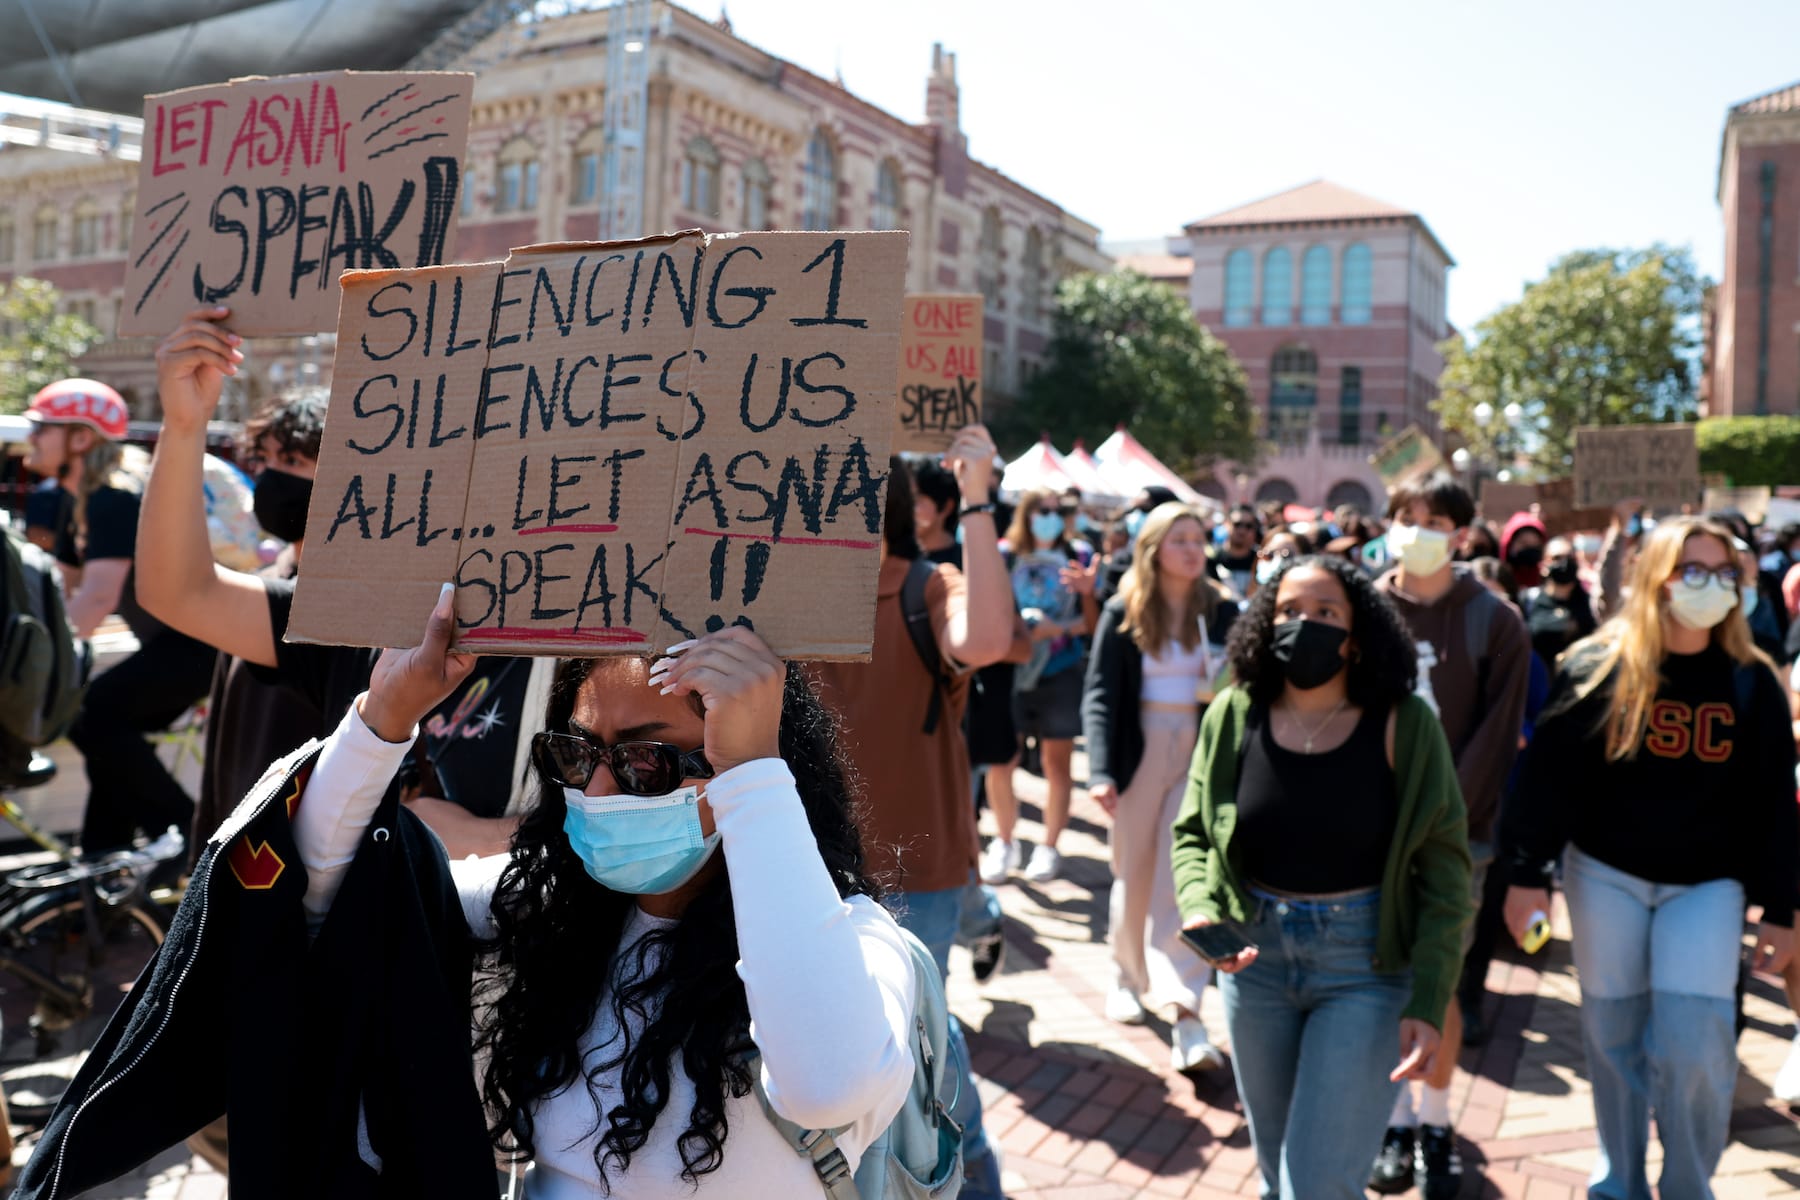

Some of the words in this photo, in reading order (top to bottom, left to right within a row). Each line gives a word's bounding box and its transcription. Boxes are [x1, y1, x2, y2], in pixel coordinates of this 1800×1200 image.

[152, 99, 228, 178] LET
[223, 80, 352, 178] ASNA
[193, 156, 459, 304] SPEAK!
[361, 246, 777, 361] SILENCING
[789, 239, 869, 329] 1
[913, 301, 974, 330] ONE
[346, 350, 708, 455] SILENCES
[740, 352, 858, 432] US
[900, 374, 979, 432] SPEAK
[906, 343, 939, 374] US
[512, 449, 645, 530] LET
[674, 436, 888, 543] ASNA
